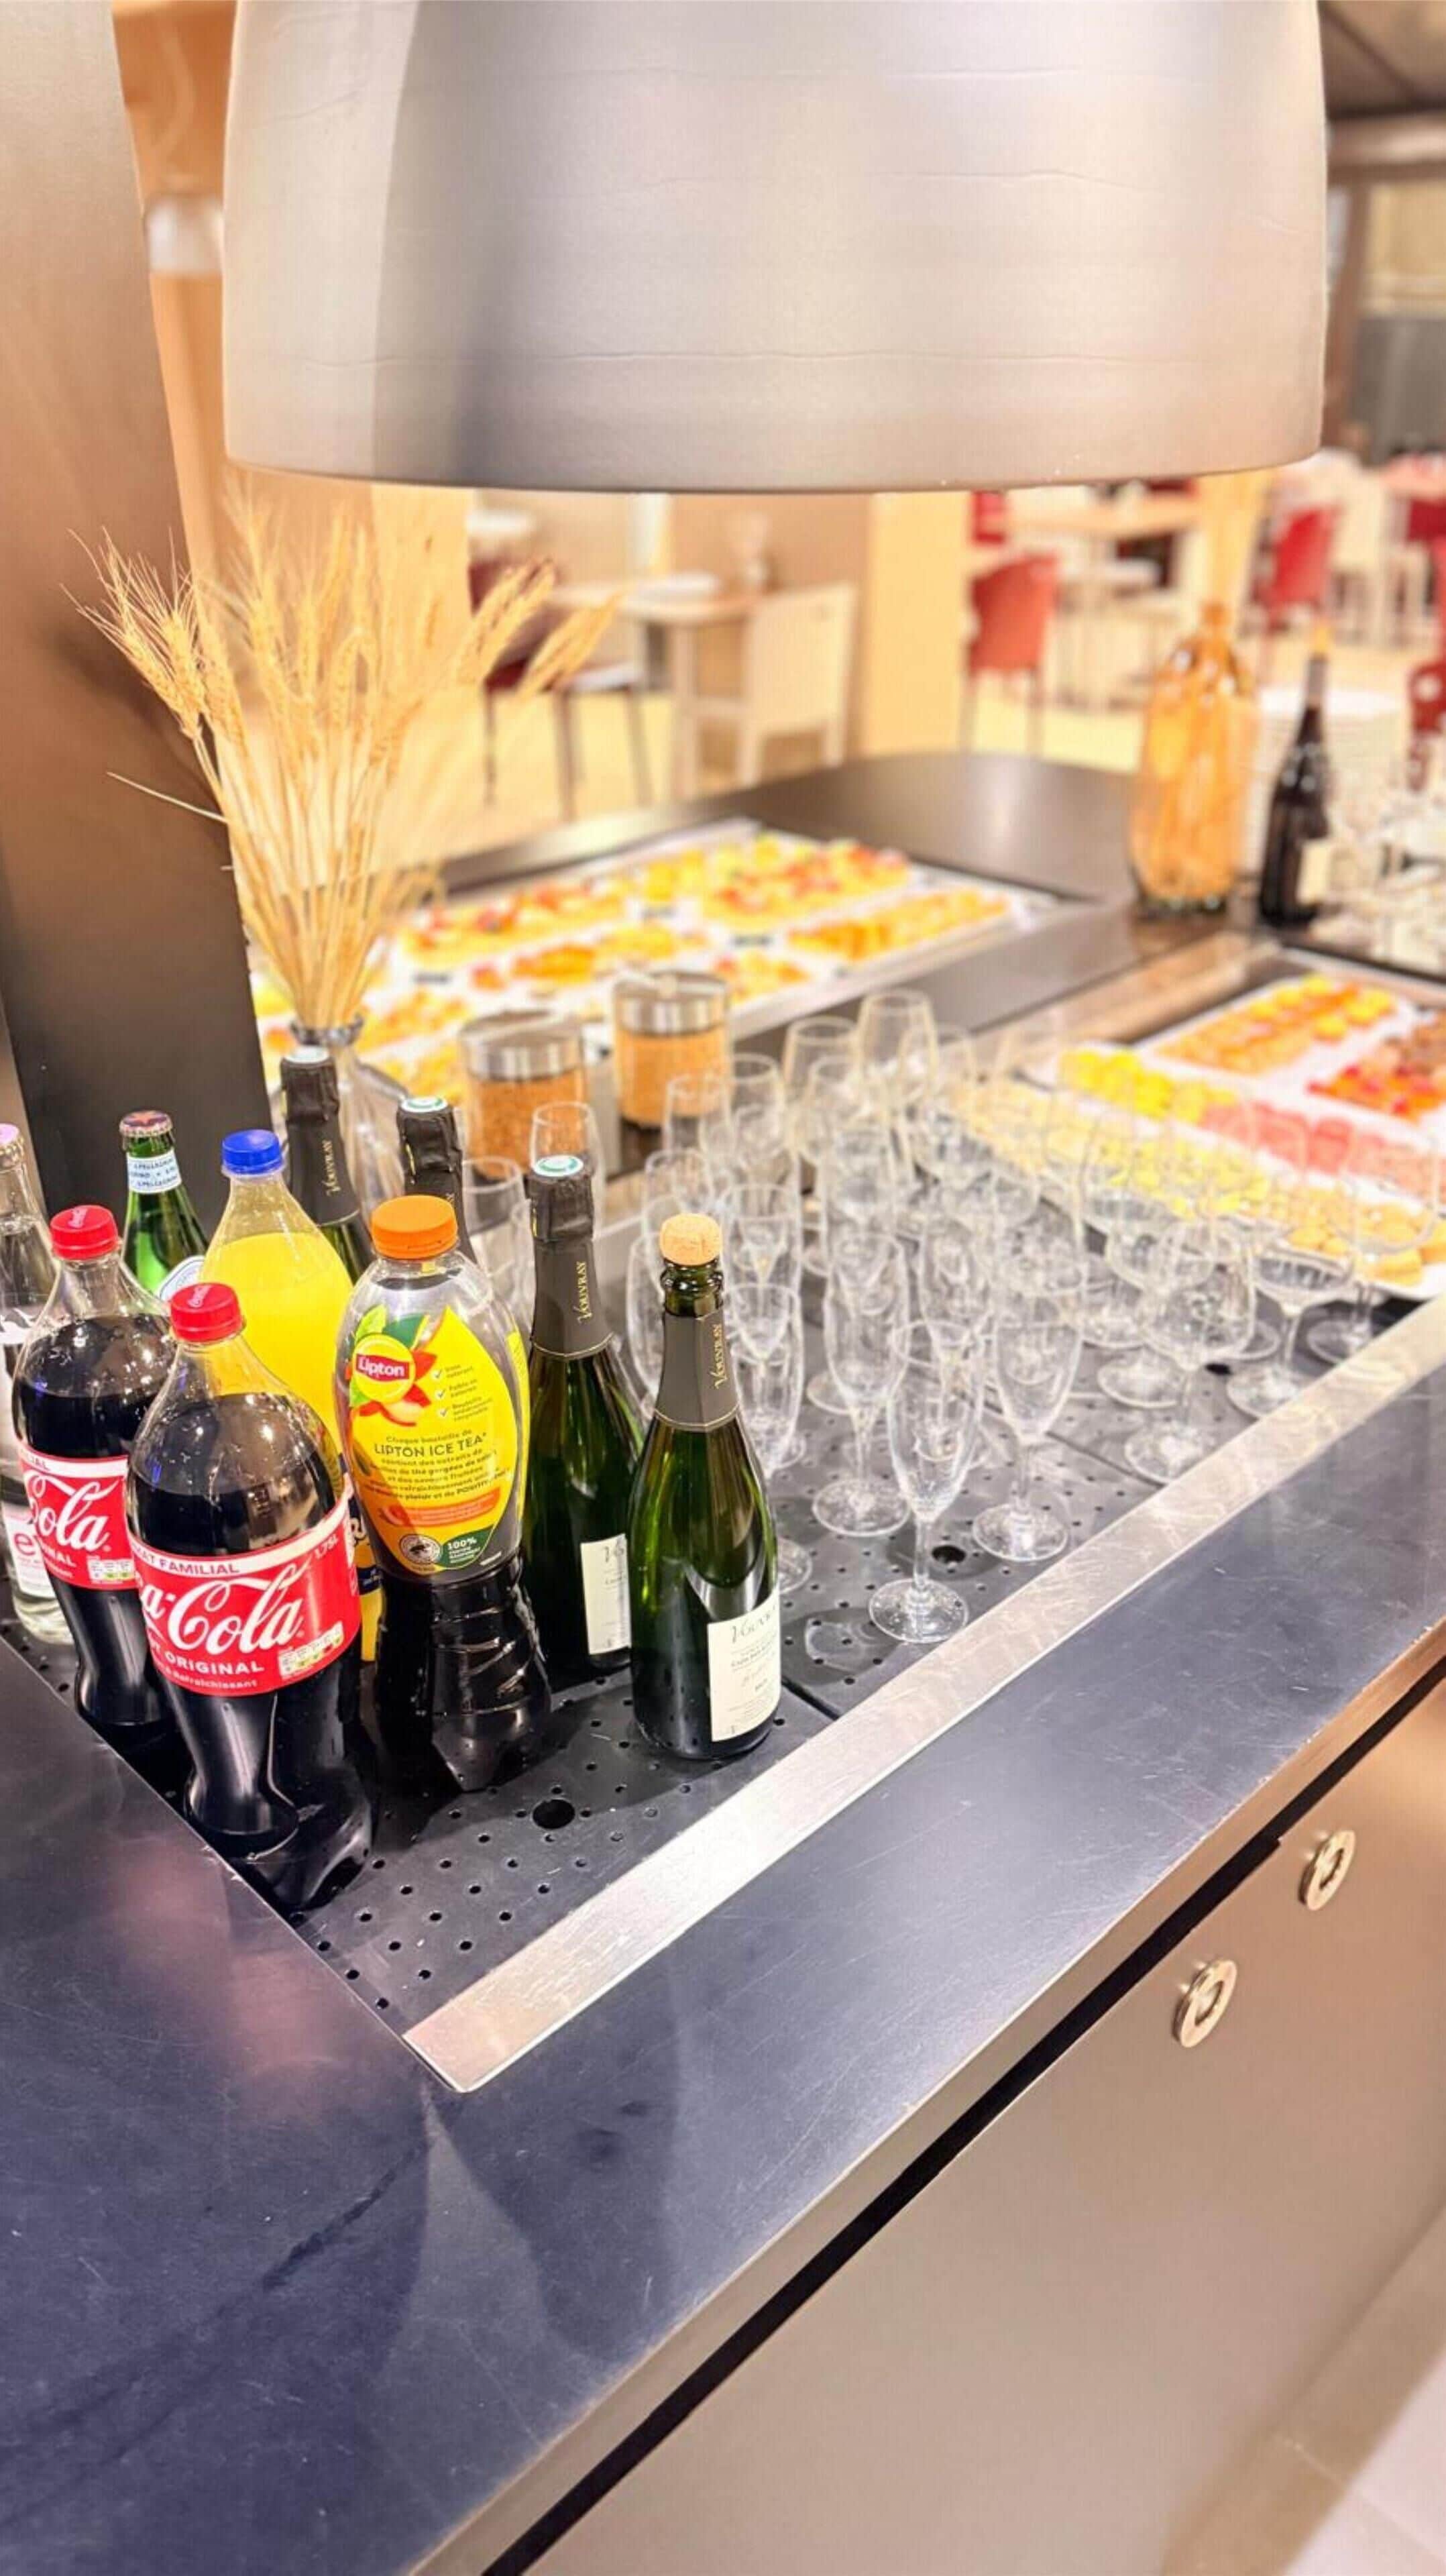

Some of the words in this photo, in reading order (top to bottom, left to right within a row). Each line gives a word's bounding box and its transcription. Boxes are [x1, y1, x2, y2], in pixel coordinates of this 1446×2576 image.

[358, 1356, 405, 1379] Lipton
[374, 1443, 425, 1457] LIPTON
[430, 1444, 454, 1456] ICE
[448, 1536, 478, 1550] 100%
[159, 1558, 239, 1574] FAMILIAL
[164, 1650, 264, 1675] ORIGINAL
